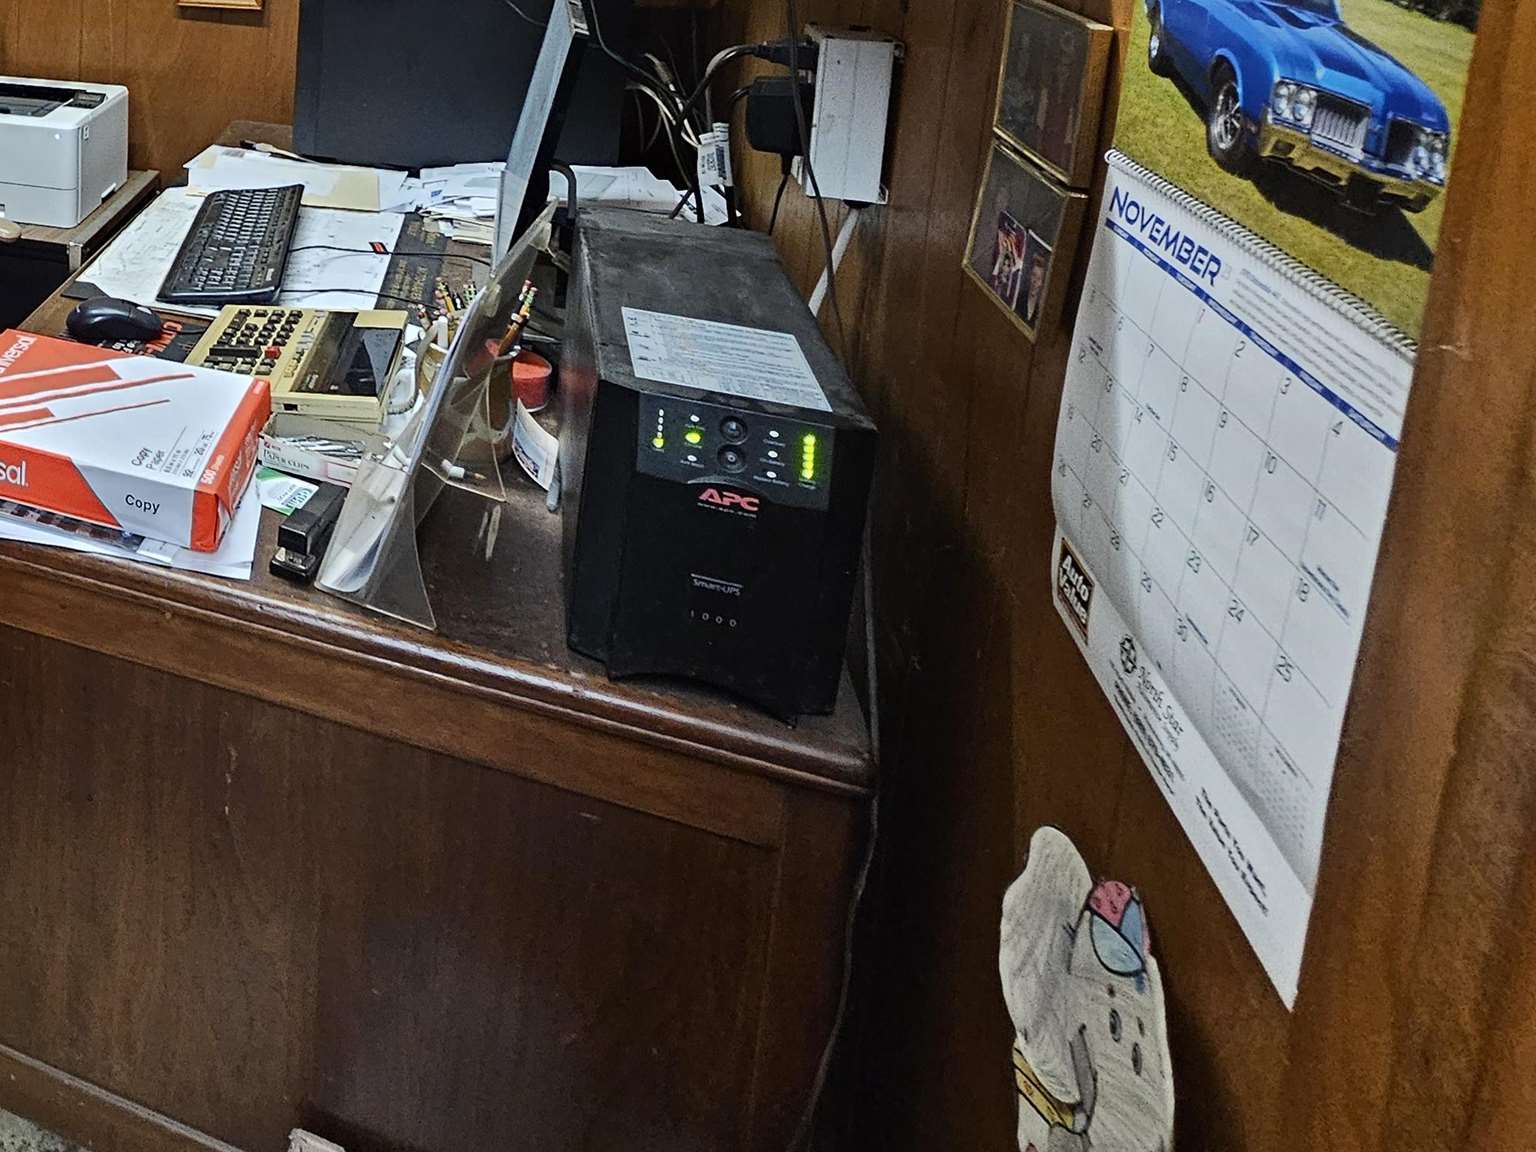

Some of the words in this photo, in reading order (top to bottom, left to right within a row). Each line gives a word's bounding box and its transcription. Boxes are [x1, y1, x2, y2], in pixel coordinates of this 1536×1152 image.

[1108, 186, 1223, 286] NOVEMBER
[1233, 340, 1246, 358] 2
[1280, 377, 1292, 395] 3
[1331, 420, 1344, 436] 4
[131, 447, 153, 466] Copy
[1148, 343, 1156, 359] 7
[1180, 376, 1189, 393] 8
[1218, 411, 1228, 429] 9
[1265, 450, 1278, 474] 10
[1315, 498, 1327, 521] 11
[201, 469, 216, 485] 500
[264, 449, 286, 464] PAPER
[288, 460, 310, 469] CLIPS
[125, 494, 160, 515] Copy
[698, 488, 760, 512] APC
[1167, 440, 1178, 462] 15
[1204, 480, 1215, 503] 16
[1247, 525, 1260, 546] 17
[1296, 577, 1310, 603] 18
[693, 579, 740, 596] Smart-UPS
[1058, 567, 1088, 625] Value
[1062, 554, 1090, 602] Auto
[1151, 506, 1164, 529] 22
[1186, 549, 1201, 574] 23
[1227, 598, 1245, 623] 24
[1275, 655, 1293, 683] 25
[1138, 666, 1164, 709] North
[1163, 705, 1184, 736] Star
